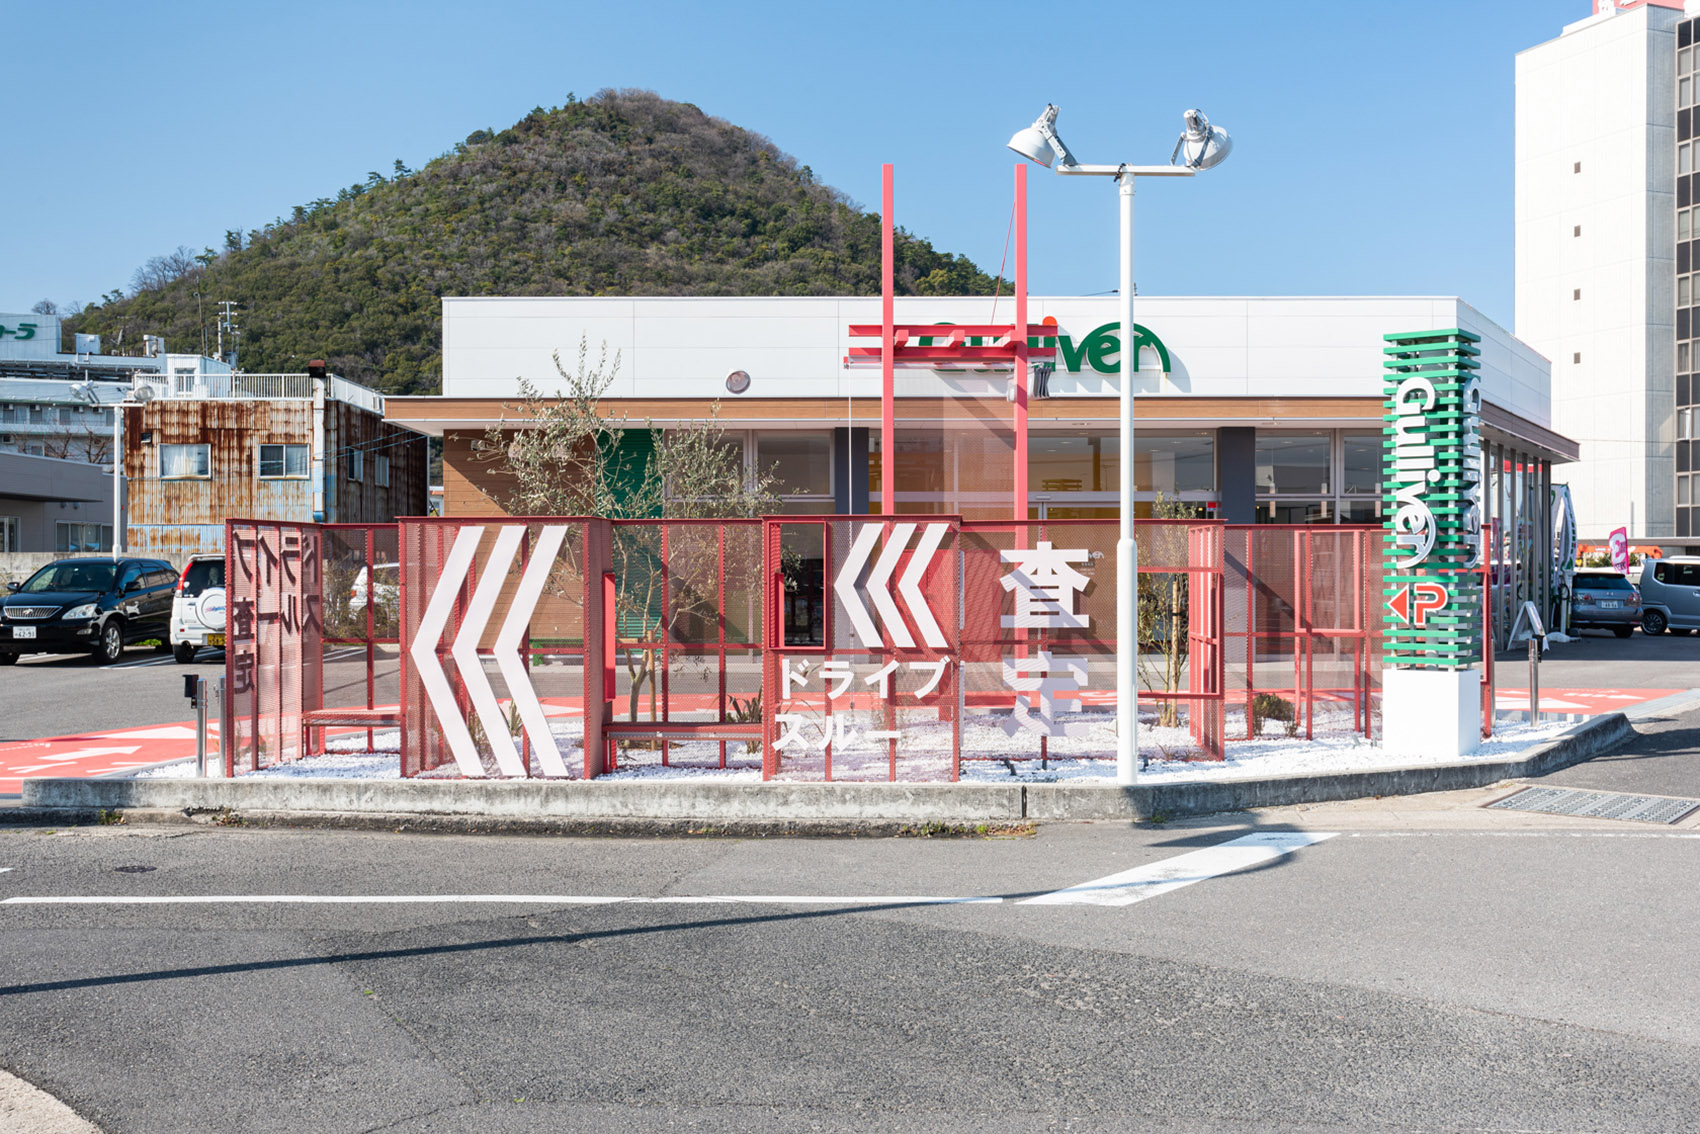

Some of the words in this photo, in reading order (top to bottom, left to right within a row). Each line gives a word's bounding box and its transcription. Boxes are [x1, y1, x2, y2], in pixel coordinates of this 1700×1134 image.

[1396, 376, 1441, 569] Gulliver
[1414, 583, 1448, 625] P
[999, 540, 1091, 738] 査定
[782, 655, 951, 700] ドライブ
[771, 713, 902, 751] スルー
